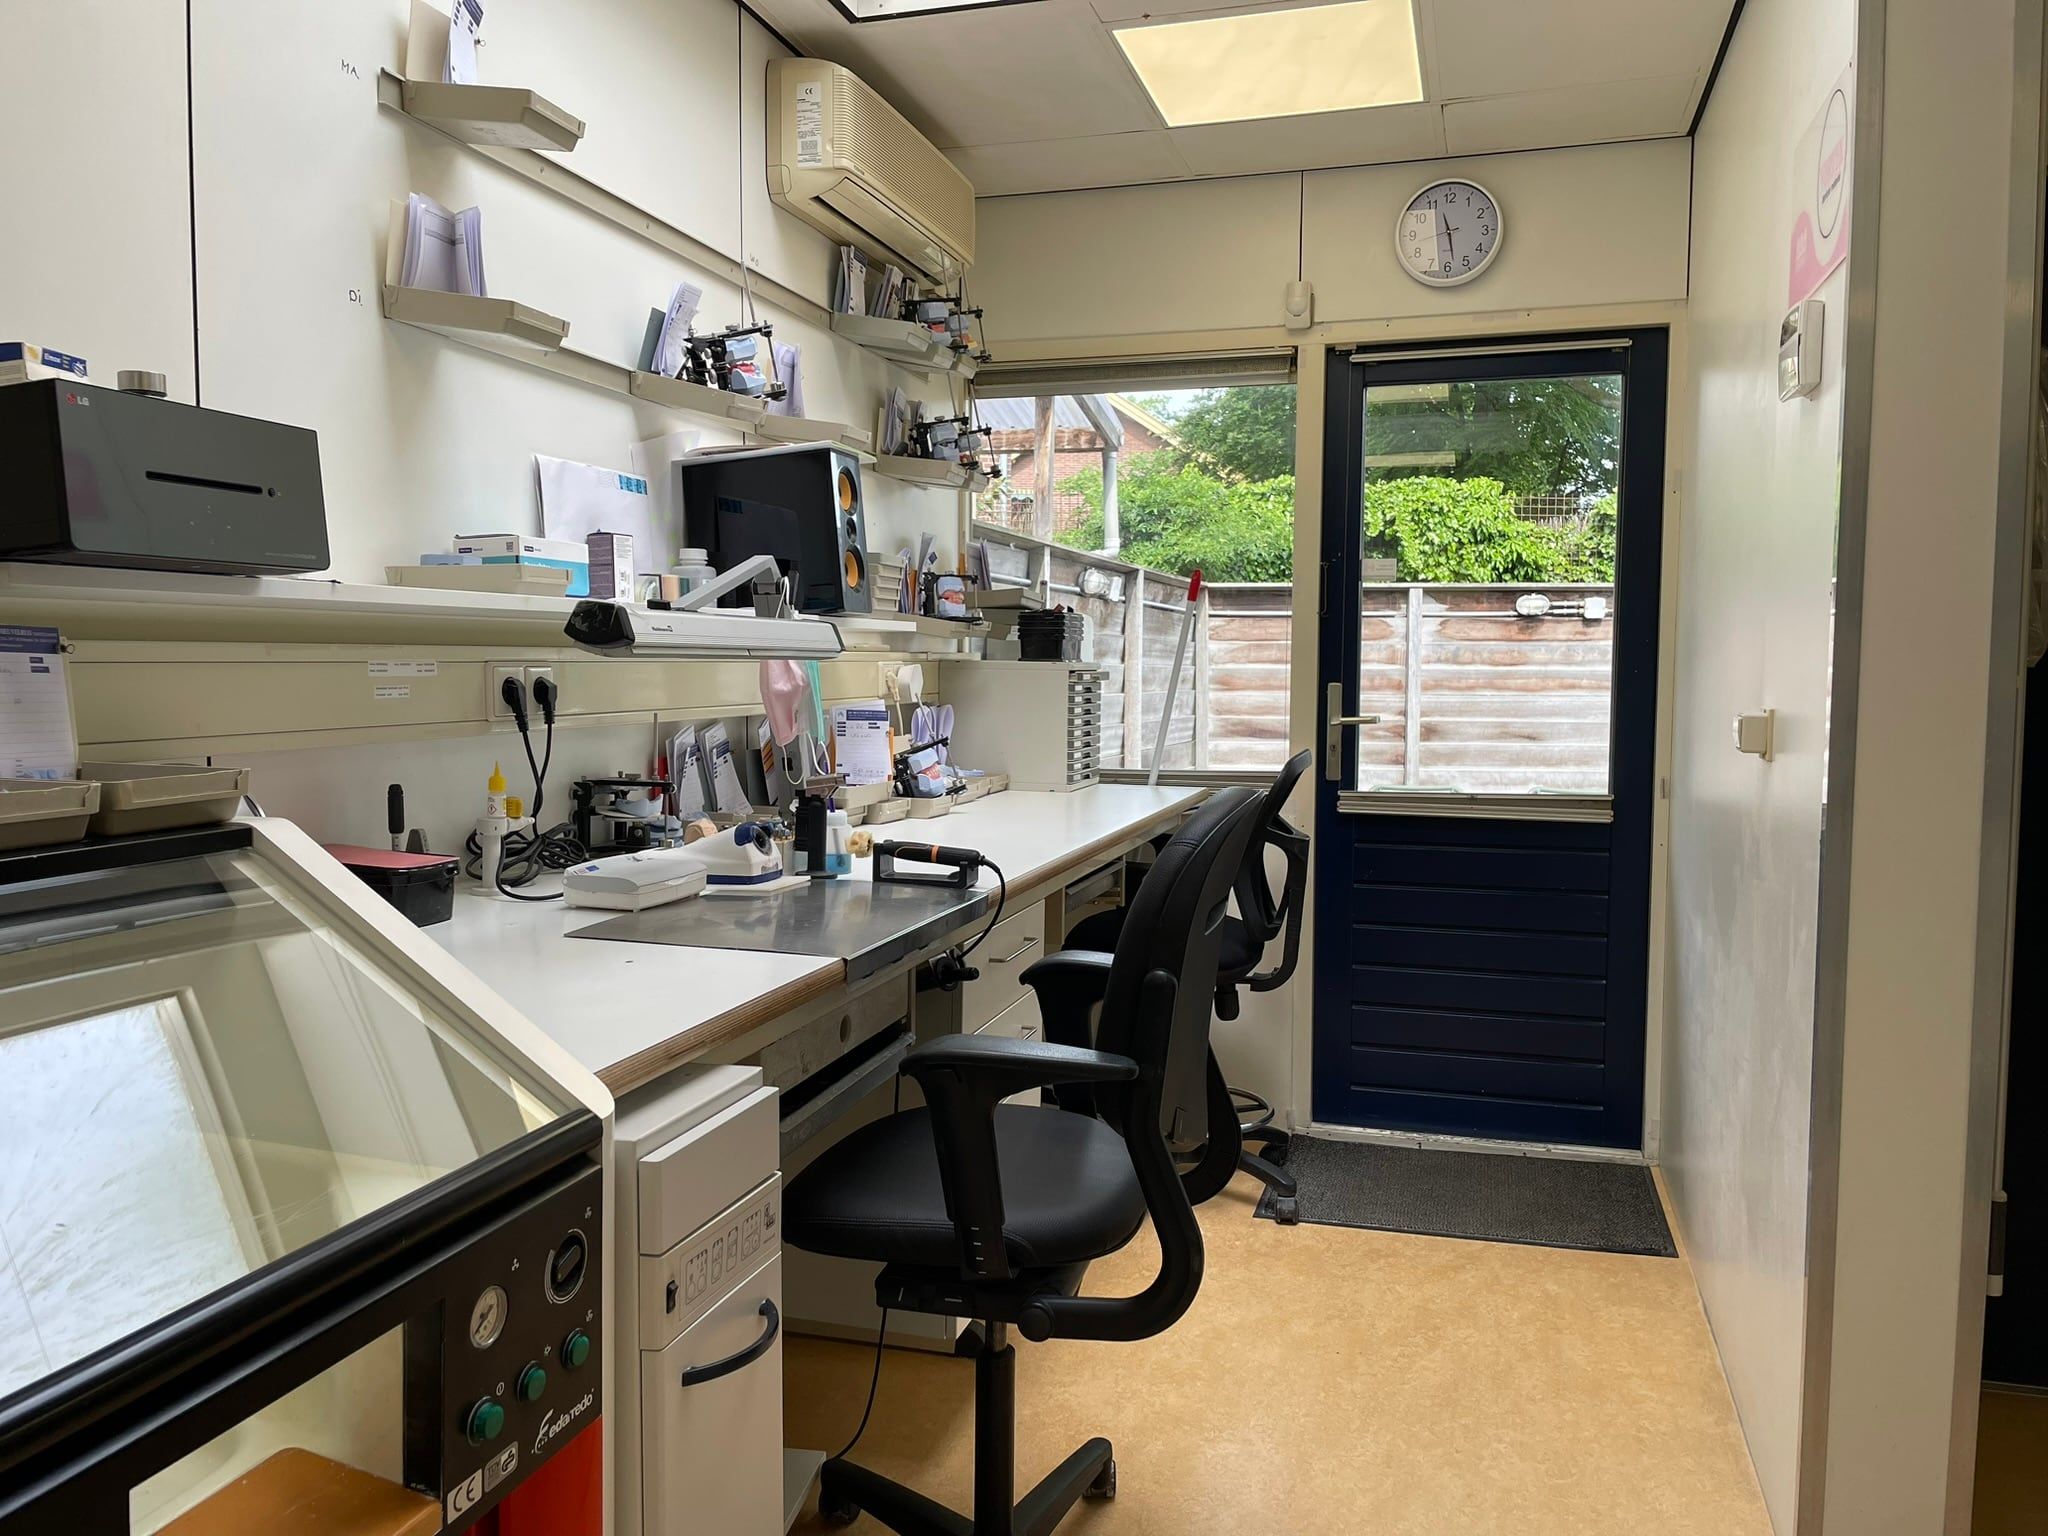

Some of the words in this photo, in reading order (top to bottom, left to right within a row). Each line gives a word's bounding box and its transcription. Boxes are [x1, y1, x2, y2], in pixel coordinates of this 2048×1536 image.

[341, 58, 360, 80] MA
[1443, 192, 1457, 204] 12
[1465, 196, 1471, 207] 1
[1426, 199, 1438, 210] 11
[1414, 212, 1427, 224] 10
[1476, 207, 1485, 219] 2
[1408, 230, 1417, 241] 9
[1481, 224, 1489, 236] 3
[1413, 247, 1421, 258] 8
[1475, 242, 1483, 253] 4
[1427, 258, 1435, 269] 7
[1461, 255, 1470, 267] 5
[1443, 261, 1452, 273] 6
[77, 396, 90, 406] LG
